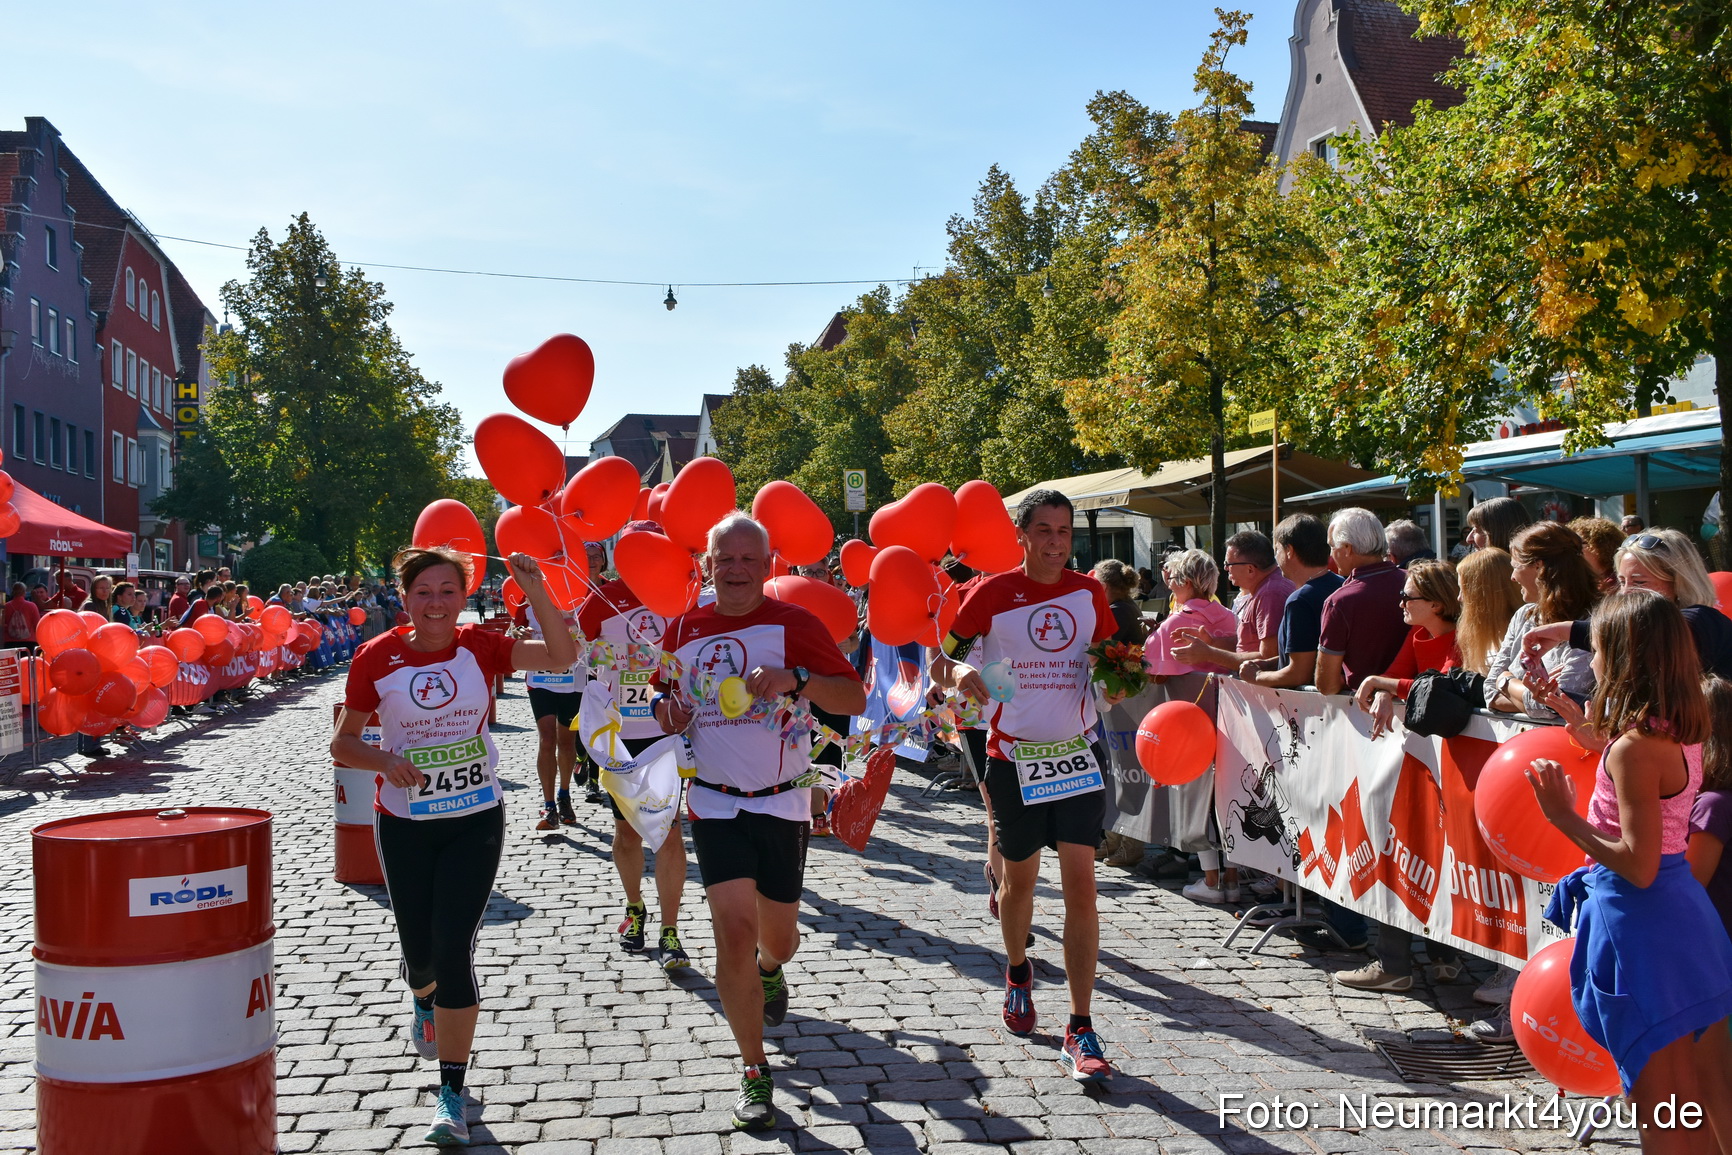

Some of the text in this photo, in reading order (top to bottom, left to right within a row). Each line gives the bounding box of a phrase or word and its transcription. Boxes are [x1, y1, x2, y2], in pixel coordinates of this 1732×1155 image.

[177, 383, 199, 440] HOT
[1253, 416, 1274, 428] Toiletten
[1011, 659, 1047, 669] LAUFEN
[1049, 661, 1065, 669] MIT
[626, 687, 648, 704] 24
[454, 708, 479, 717] HERZ
[412, 740, 484, 766] BOCK
[1021, 737, 1083, 758] BOCK
[418, 763, 484, 797] 2458
[1026, 755, 1089, 781] 2308
[1029, 776, 1095, 797] JOHANNES
[428, 793, 480, 813] RENATE
[849, 801, 881, 840] Regina
[1382, 821, 1436, 895] Braun
[1397, 872, 1410, 891] Sicher
[1409, 886, 1418, 897] ist
[1445, 843, 1519, 914] Braun
[1538, 881, 1555, 897] D-92
[149, 877, 234, 906] RÖDL
[1474, 909, 1528, 935] Sicher ist sicher
[1541, 921, 1555, 936] Fax
[37, 991, 125, 1041] AVIA
[1522, 1011, 1606, 1067] RÖDL
[1557, 1049, 1602, 1072] energie
